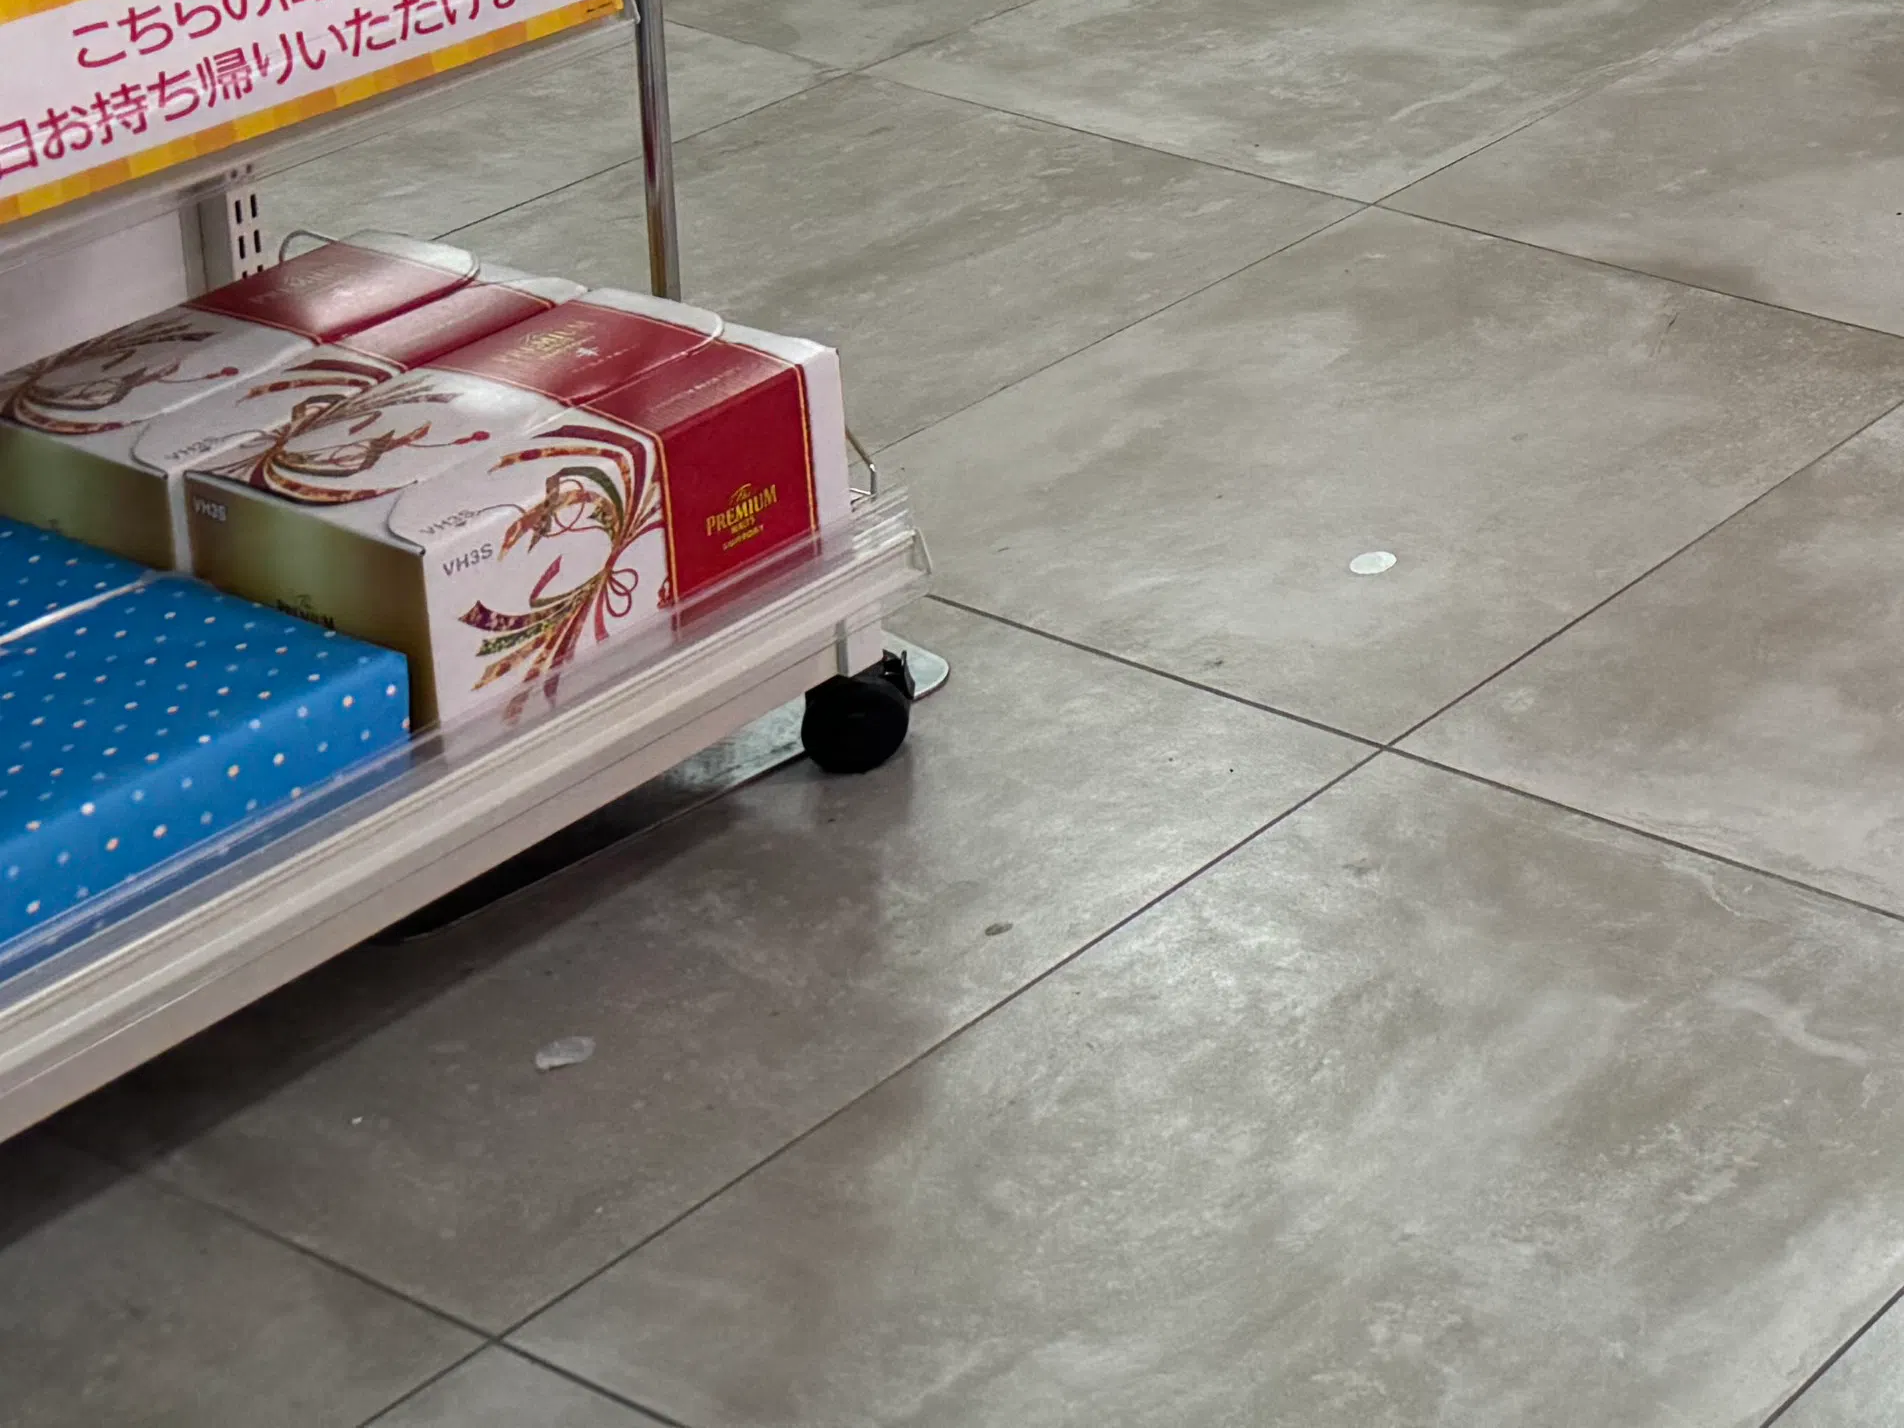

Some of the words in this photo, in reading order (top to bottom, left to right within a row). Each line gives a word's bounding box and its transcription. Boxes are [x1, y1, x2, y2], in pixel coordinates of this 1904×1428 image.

[191, 494, 228, 523] VH3S
[705, 483, 778, 537] PREMIUM
[442, 541, 495, 578] VH3S
